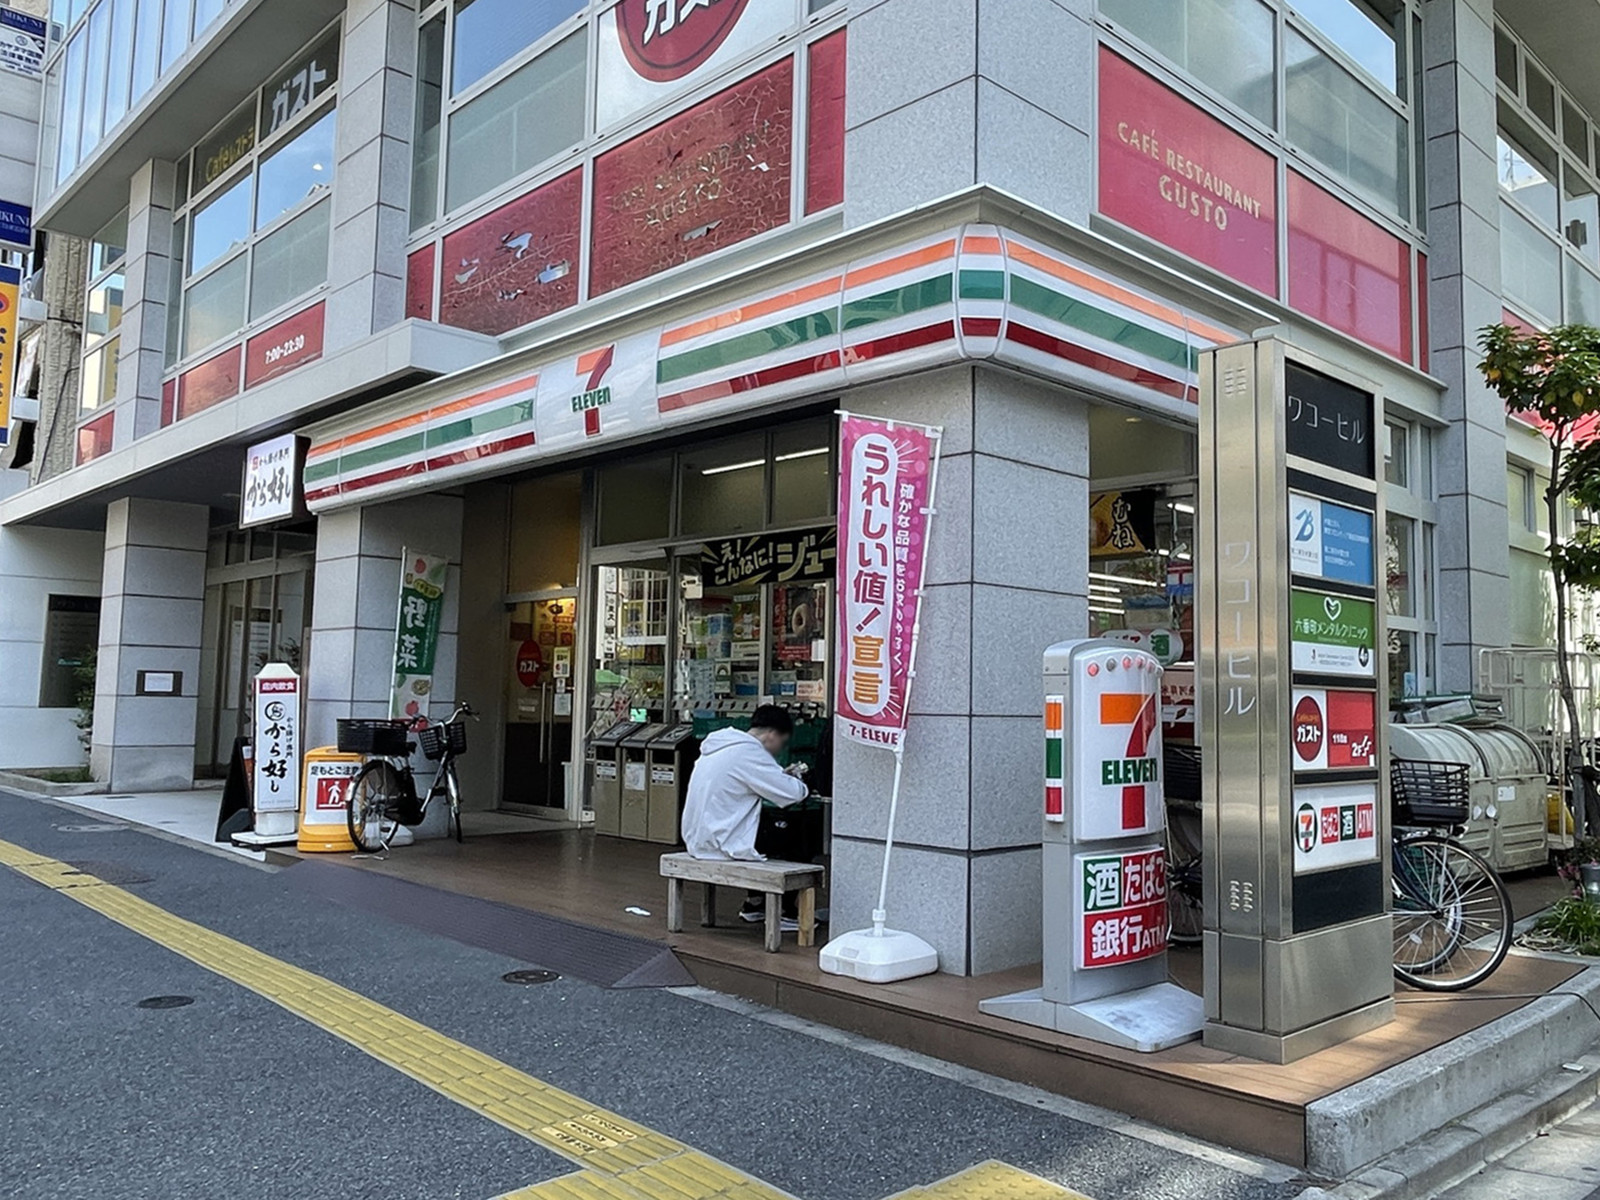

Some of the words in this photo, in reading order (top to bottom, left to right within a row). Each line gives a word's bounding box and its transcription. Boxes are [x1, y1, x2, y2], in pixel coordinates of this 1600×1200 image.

[270, 60, 326, 134] ガスト
[1117, 121, 1159, 160] CAFÉ
[1166, 148, 1262, 219] RESTAURANT
[1158, 174, 1228, 231] GUSTO
[576, 343, 615, 436] 7
[714, 541, 775, 586] こんなに!
[261, 722, 288, 793] から好し
[1100, 692, 1157, 830] 7
[1296, 724, 1321, 743] ガスト
[1086, 861, 1120, 909] 酒
[1124, 856, 1165, 904] たばこ
